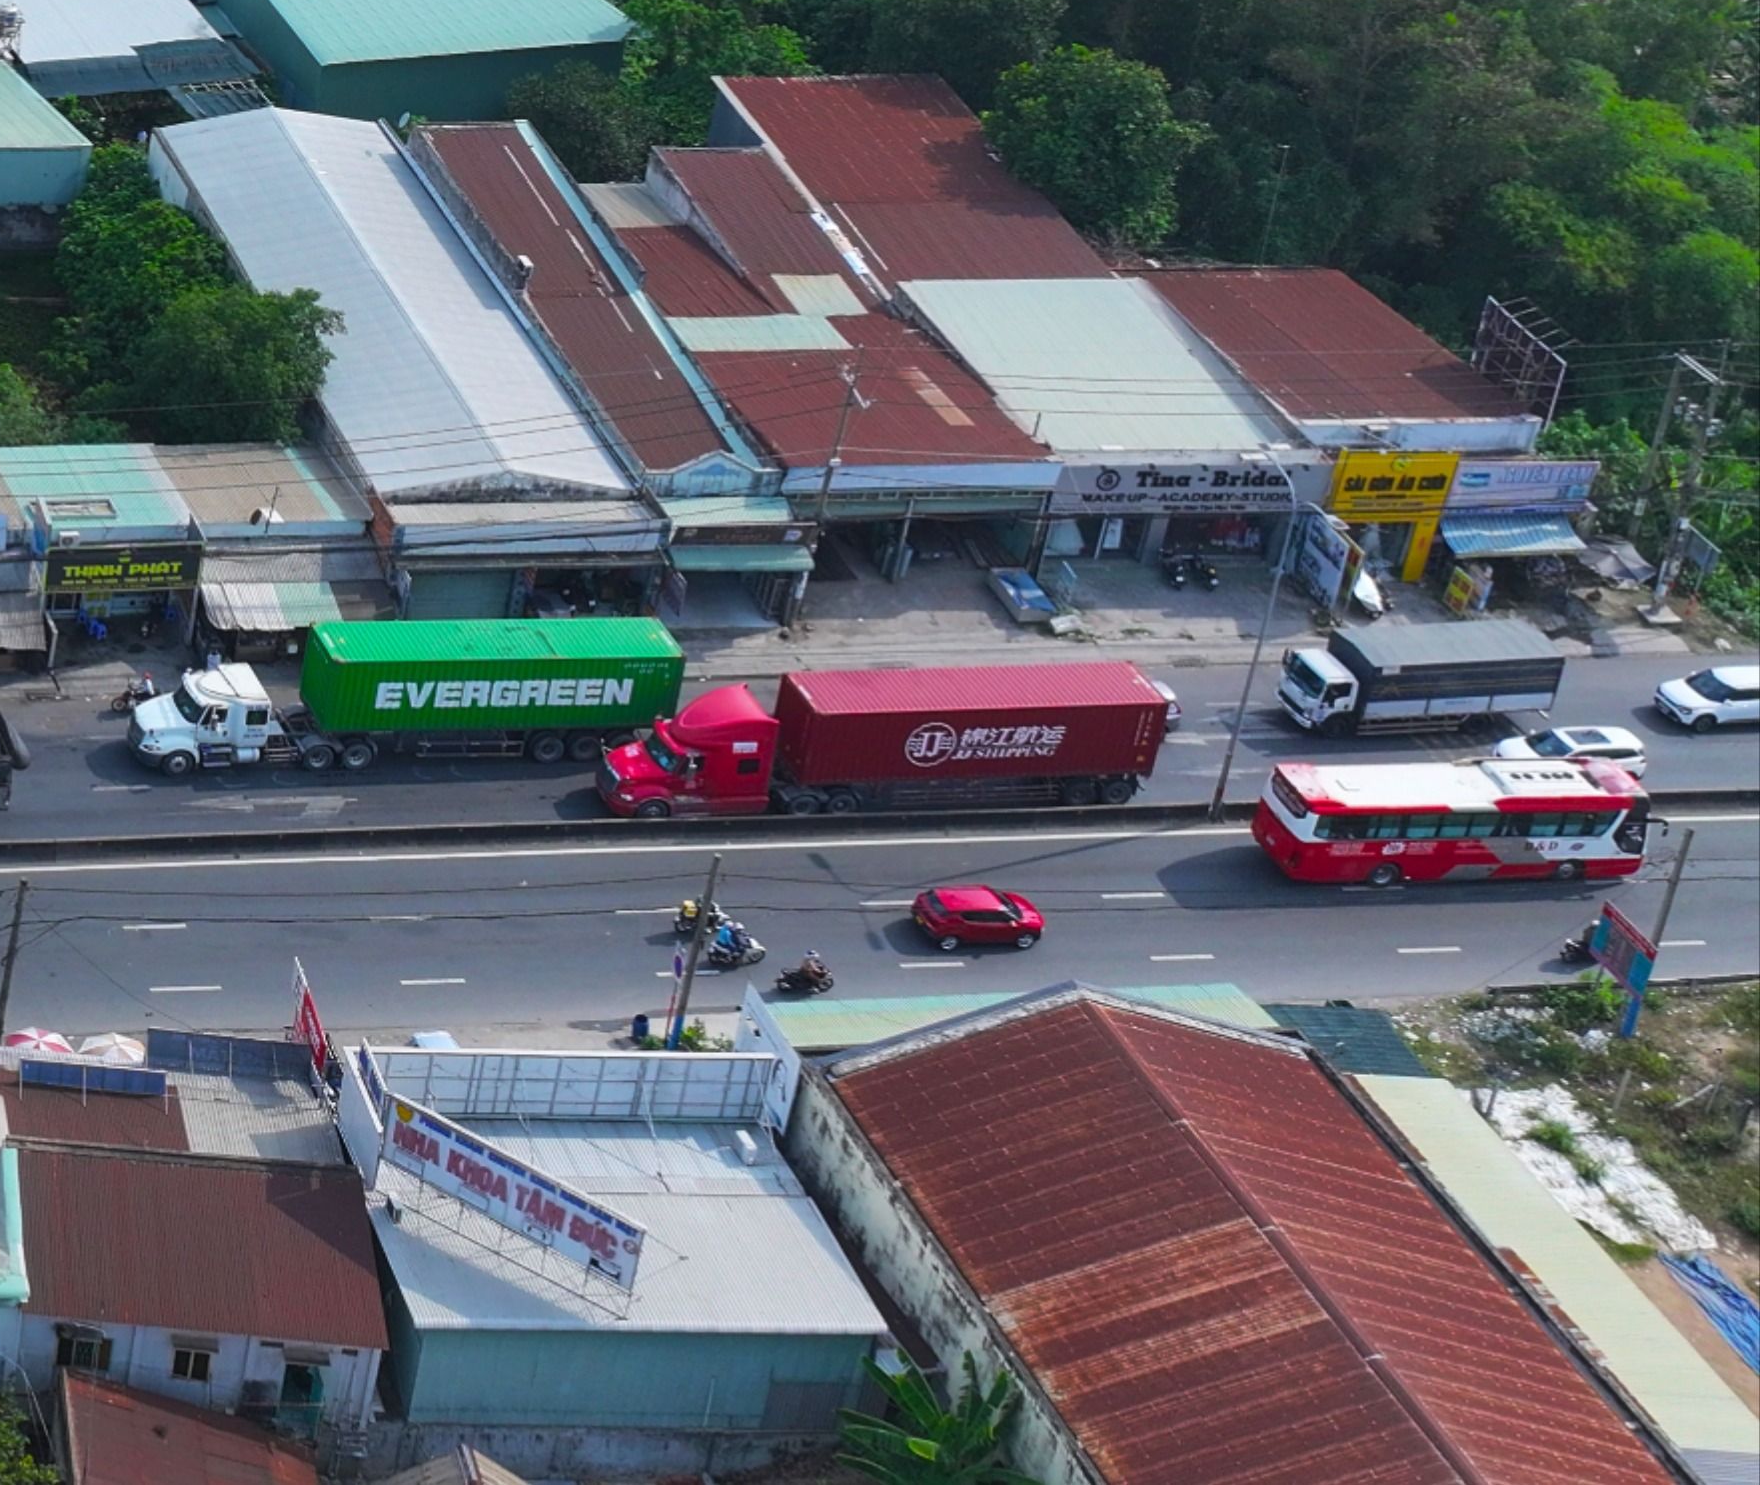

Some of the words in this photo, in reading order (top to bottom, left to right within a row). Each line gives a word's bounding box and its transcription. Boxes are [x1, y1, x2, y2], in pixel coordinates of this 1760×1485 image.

[1136, 470, 1191, 488] Tina
[1210, 469, 1292, 488] Bridal
[63, 564, 123, 579] THỊNH
[129, 560, 183, 575] PHÁT
[375, 678, 634, 709] EVERGREEN
[974, 745, 1056, 759] SHIPPING
[393, 1121, 440, 1167] NHA
[446, 1147, 509, 1203] KHOA
[514, 1183, 568, 1233] TÂM
[568, 1214, 619, 1260] ĐỨC
